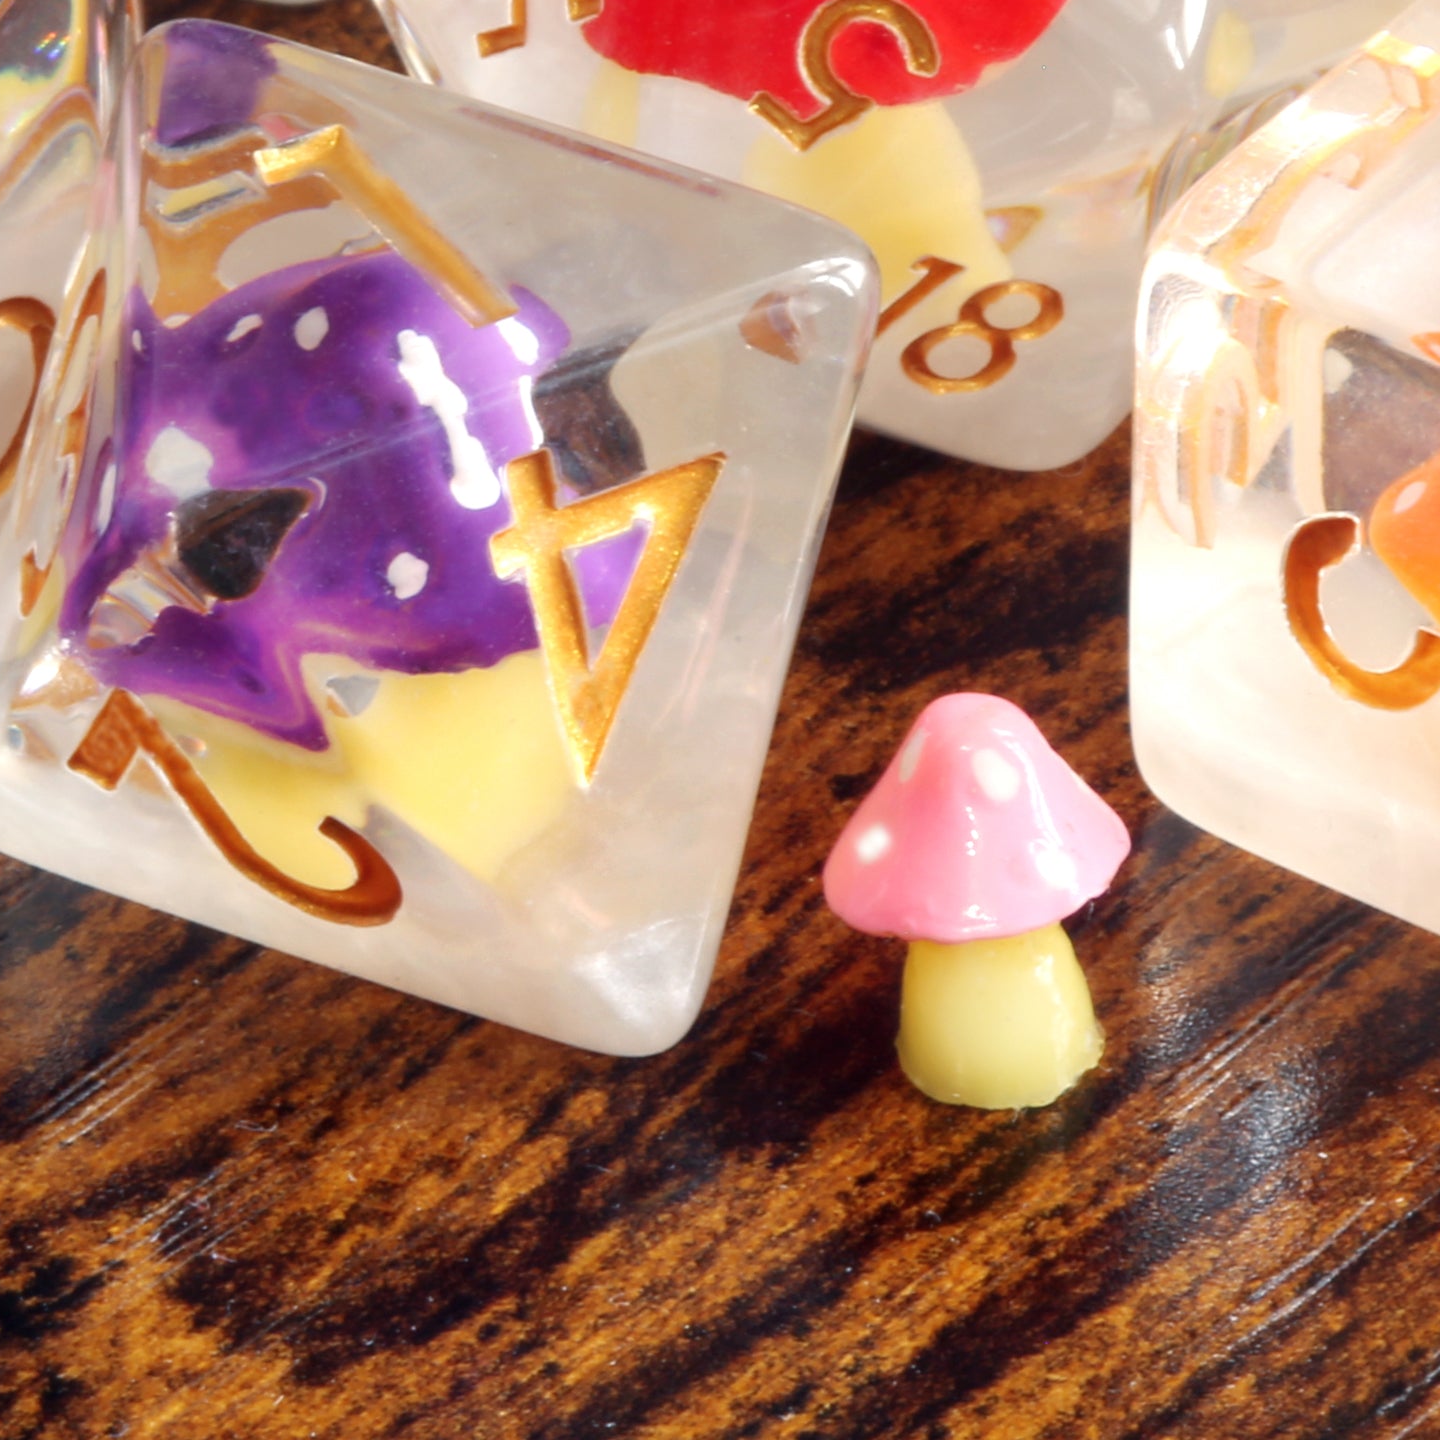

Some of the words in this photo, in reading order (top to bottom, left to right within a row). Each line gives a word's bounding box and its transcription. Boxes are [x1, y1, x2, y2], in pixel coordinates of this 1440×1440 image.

[253, 124, 517, 329] 1
[874, 253, 1067, 396] 18
[490, 448, 728, 790] 4
